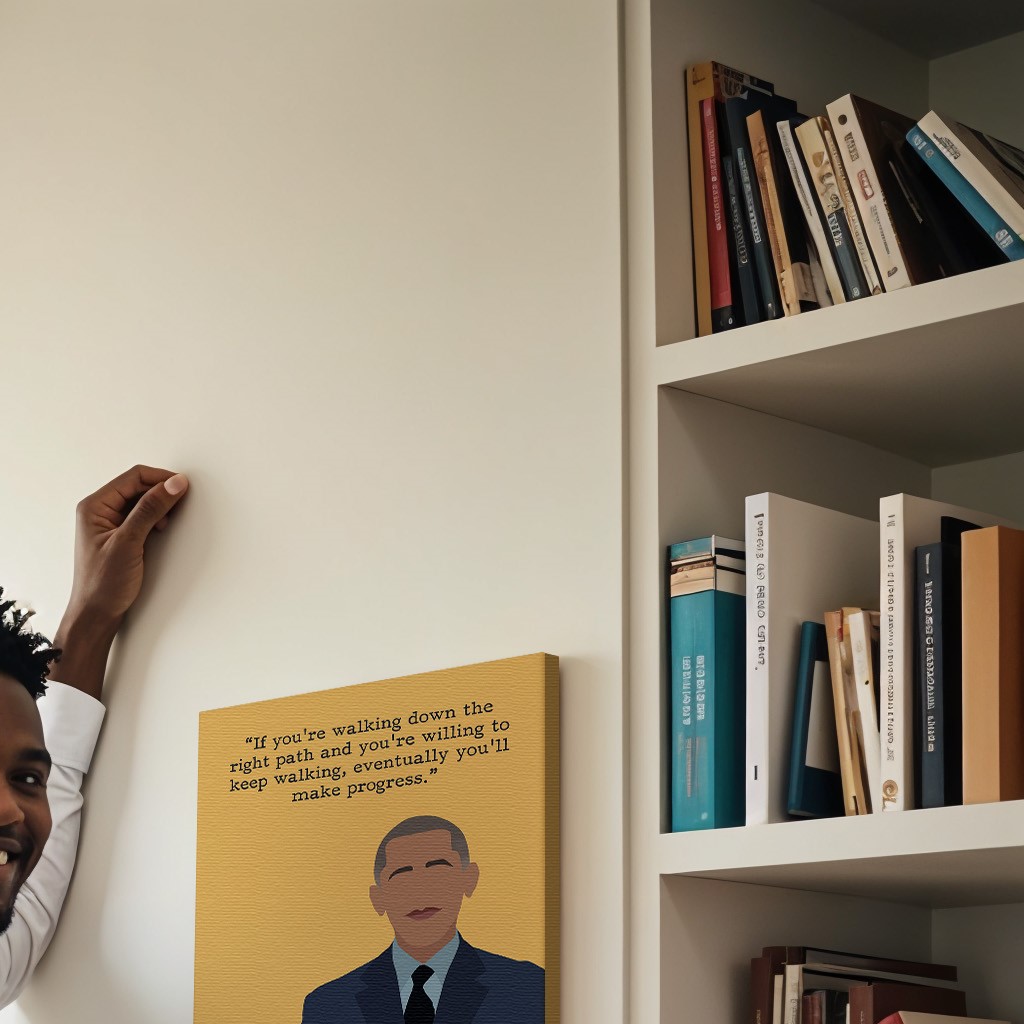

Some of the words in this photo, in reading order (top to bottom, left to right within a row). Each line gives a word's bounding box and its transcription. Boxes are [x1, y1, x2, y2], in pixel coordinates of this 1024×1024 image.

[229, 755, 270, 775] right
[275, 748, 315, 770] path
[320, 741, 353, 759] and
[358, 733, 415, 756] you're
[421, 723, 485, 742] willing
[491, 719, 510, 733] to
[272, 728, 326, 750] you're
[332, 717, 402, 736] walking
[408, 708, 456, 725] down
[463, 701, 493, 716] the
[229, 777, 268, 792] keep
[273, 765, 347, 785] walking,
[353, 748, 449, 774] eventually
[455, 737, 510, 762] you'll
[291, 785, 341, 802] make
